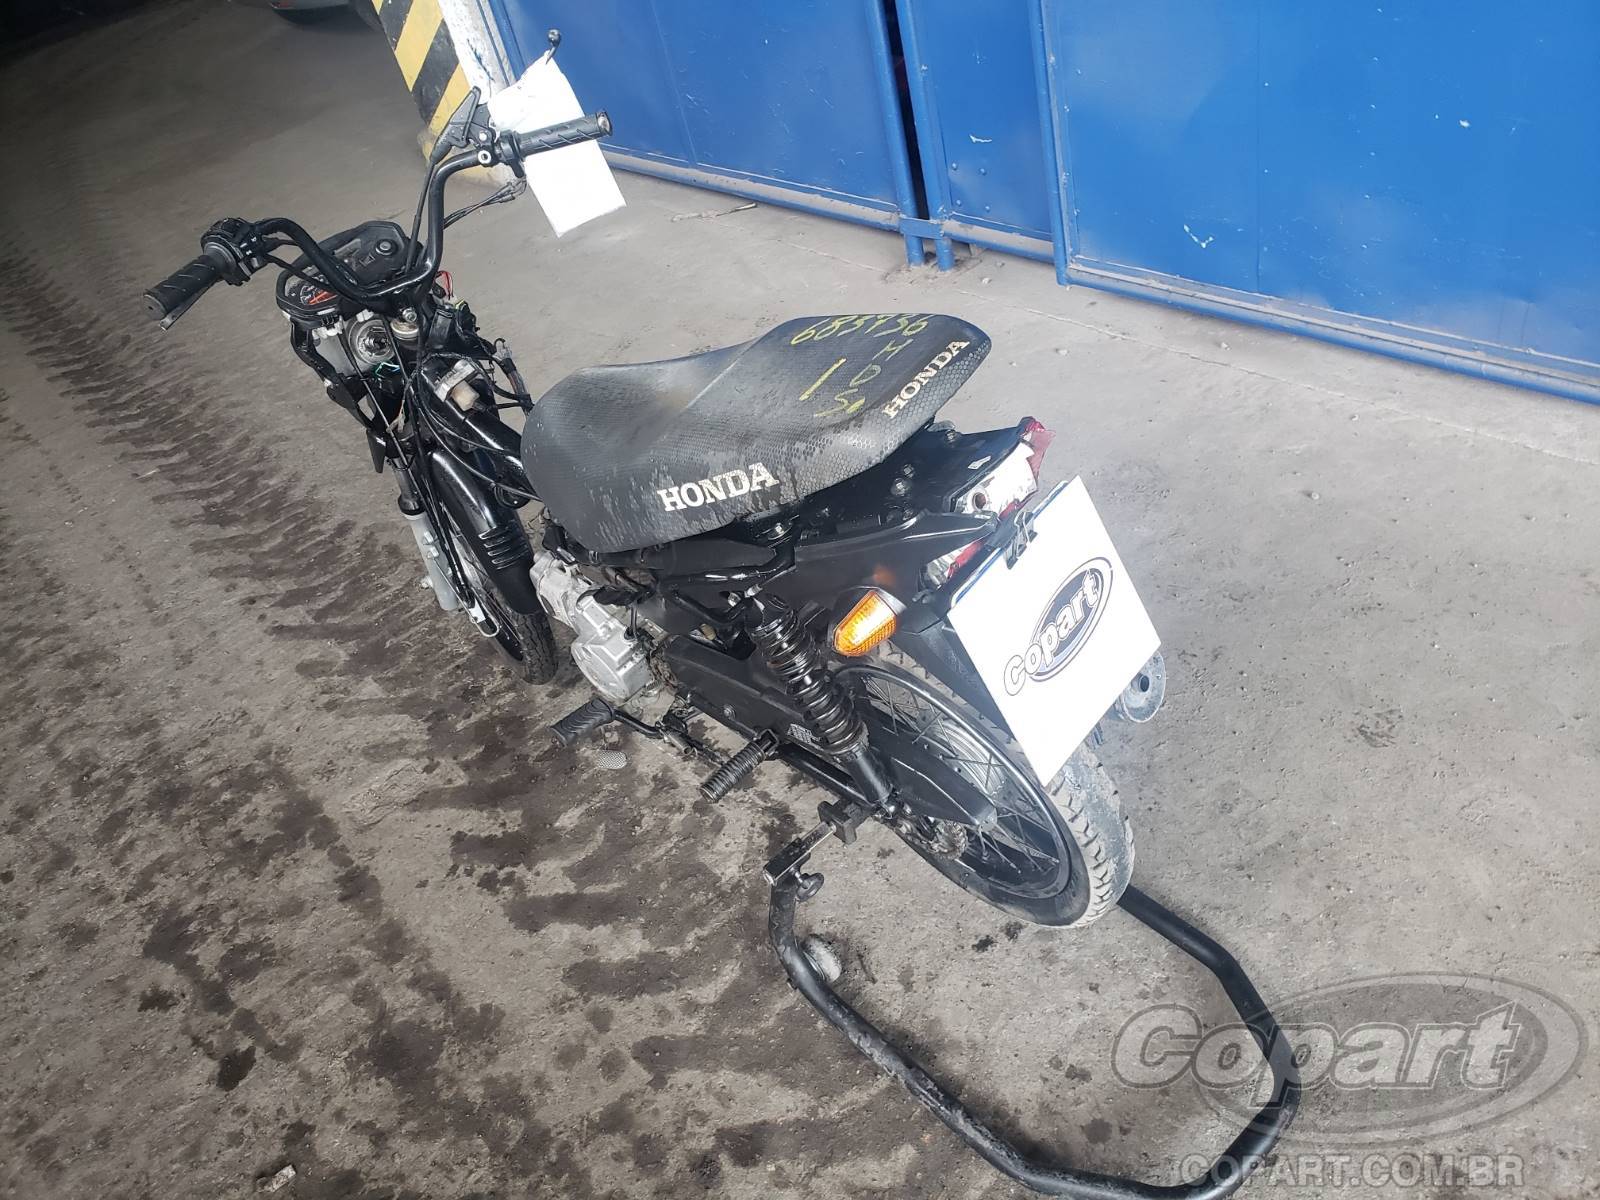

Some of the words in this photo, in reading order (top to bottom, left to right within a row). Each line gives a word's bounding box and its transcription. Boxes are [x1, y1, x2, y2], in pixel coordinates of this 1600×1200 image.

[882, 340, 970, 419] HONDA
[656, 462, 780, 512] HONDA
[1003, 568, 1099, 696] Copart
